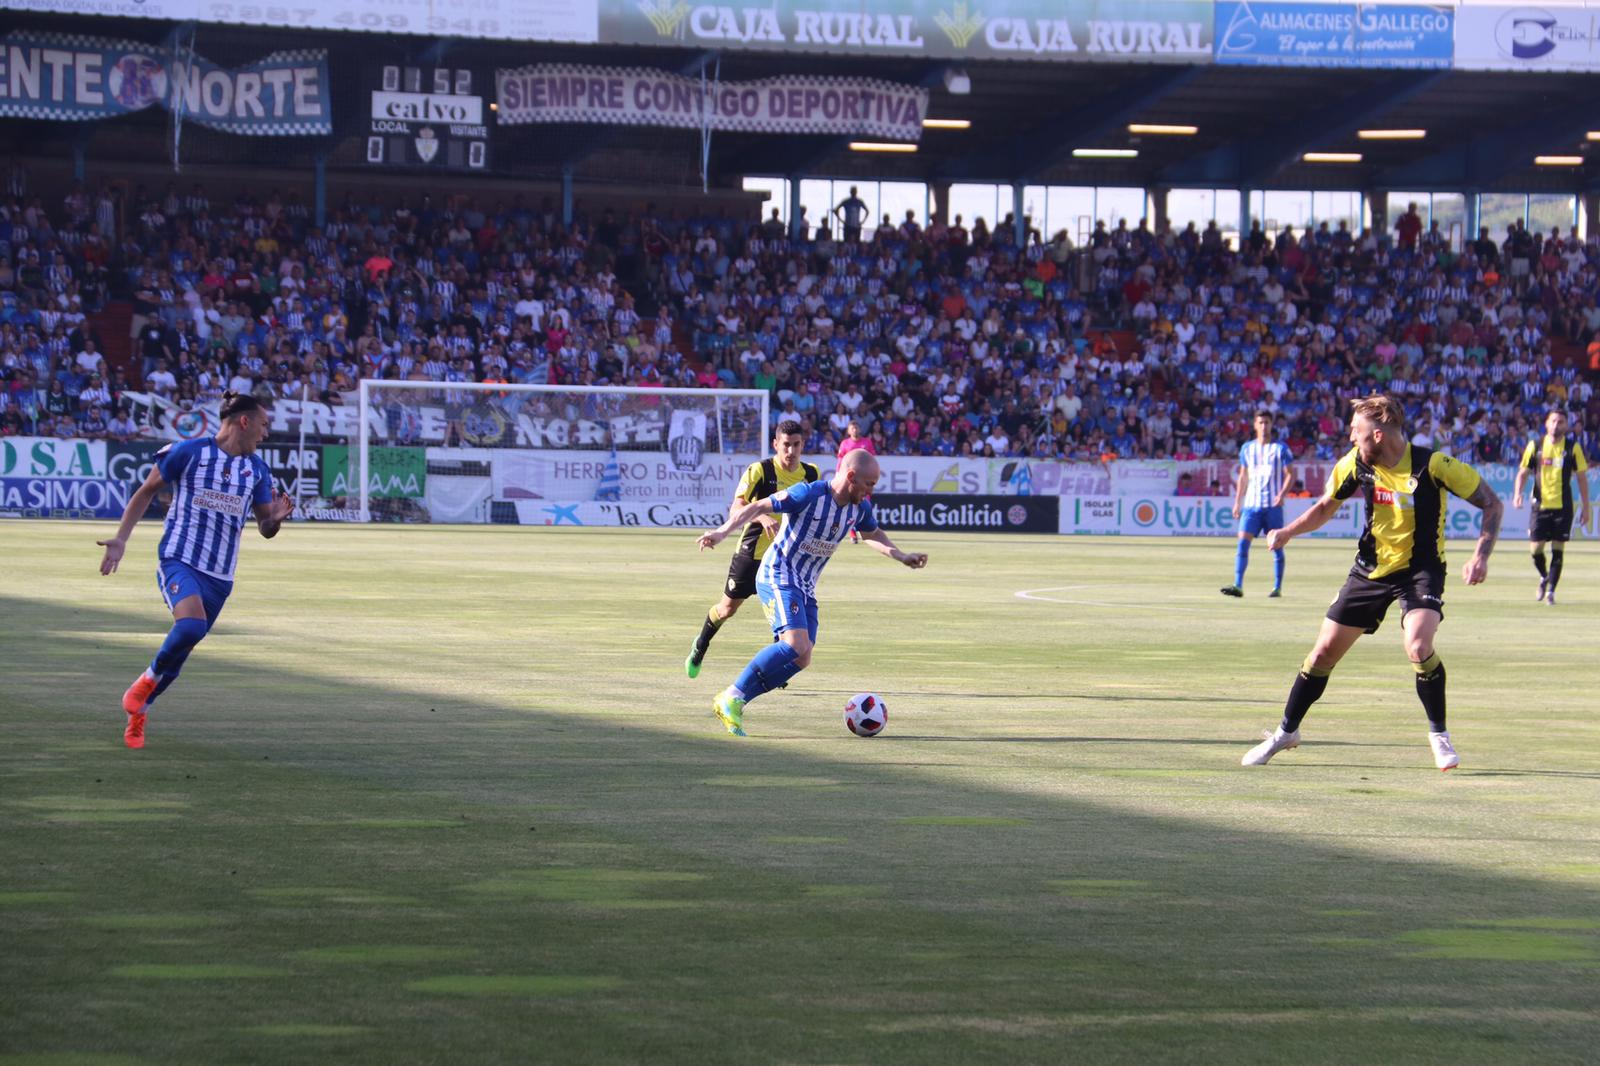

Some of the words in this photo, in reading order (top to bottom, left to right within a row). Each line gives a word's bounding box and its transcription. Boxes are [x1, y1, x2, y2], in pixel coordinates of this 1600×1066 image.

[333, 12, 408, 27] 409
[427, 16, 500, 33] 348
[690, 6, 785, 42] CAJA
[794, 9, 923, 47] RURAL
[1260, 12, 1352, 31] ALMACENES
[1358, 4, 1449, 32] GALLEGO
[985, 16, 1078, 53] CAJA
[1087, 20, 1212, 53] RURAL
[171, 67, 321, 117] NORTE
[503, 78, 625, 110] SIEMPRE
[768, 87, 921, 127] DEPORTIVA
[386, 96, 466, 121] calvo
[371, 120, 411, 134] LOCAL
[450, 124, 488, 138] VISITANTE
[367, 136, 384, 163] 0
[469, 141, 486, 168] 0
[264, 399, 447, 440] FRENE
[554, 461, 648, 480] HERRRO
[203, 490, 242, 505] HERRERO
[657, 483, 670, 497] in
[930, 503, 1003, 526] Galicia
[1092, 510, 1114, 518] GLAS
